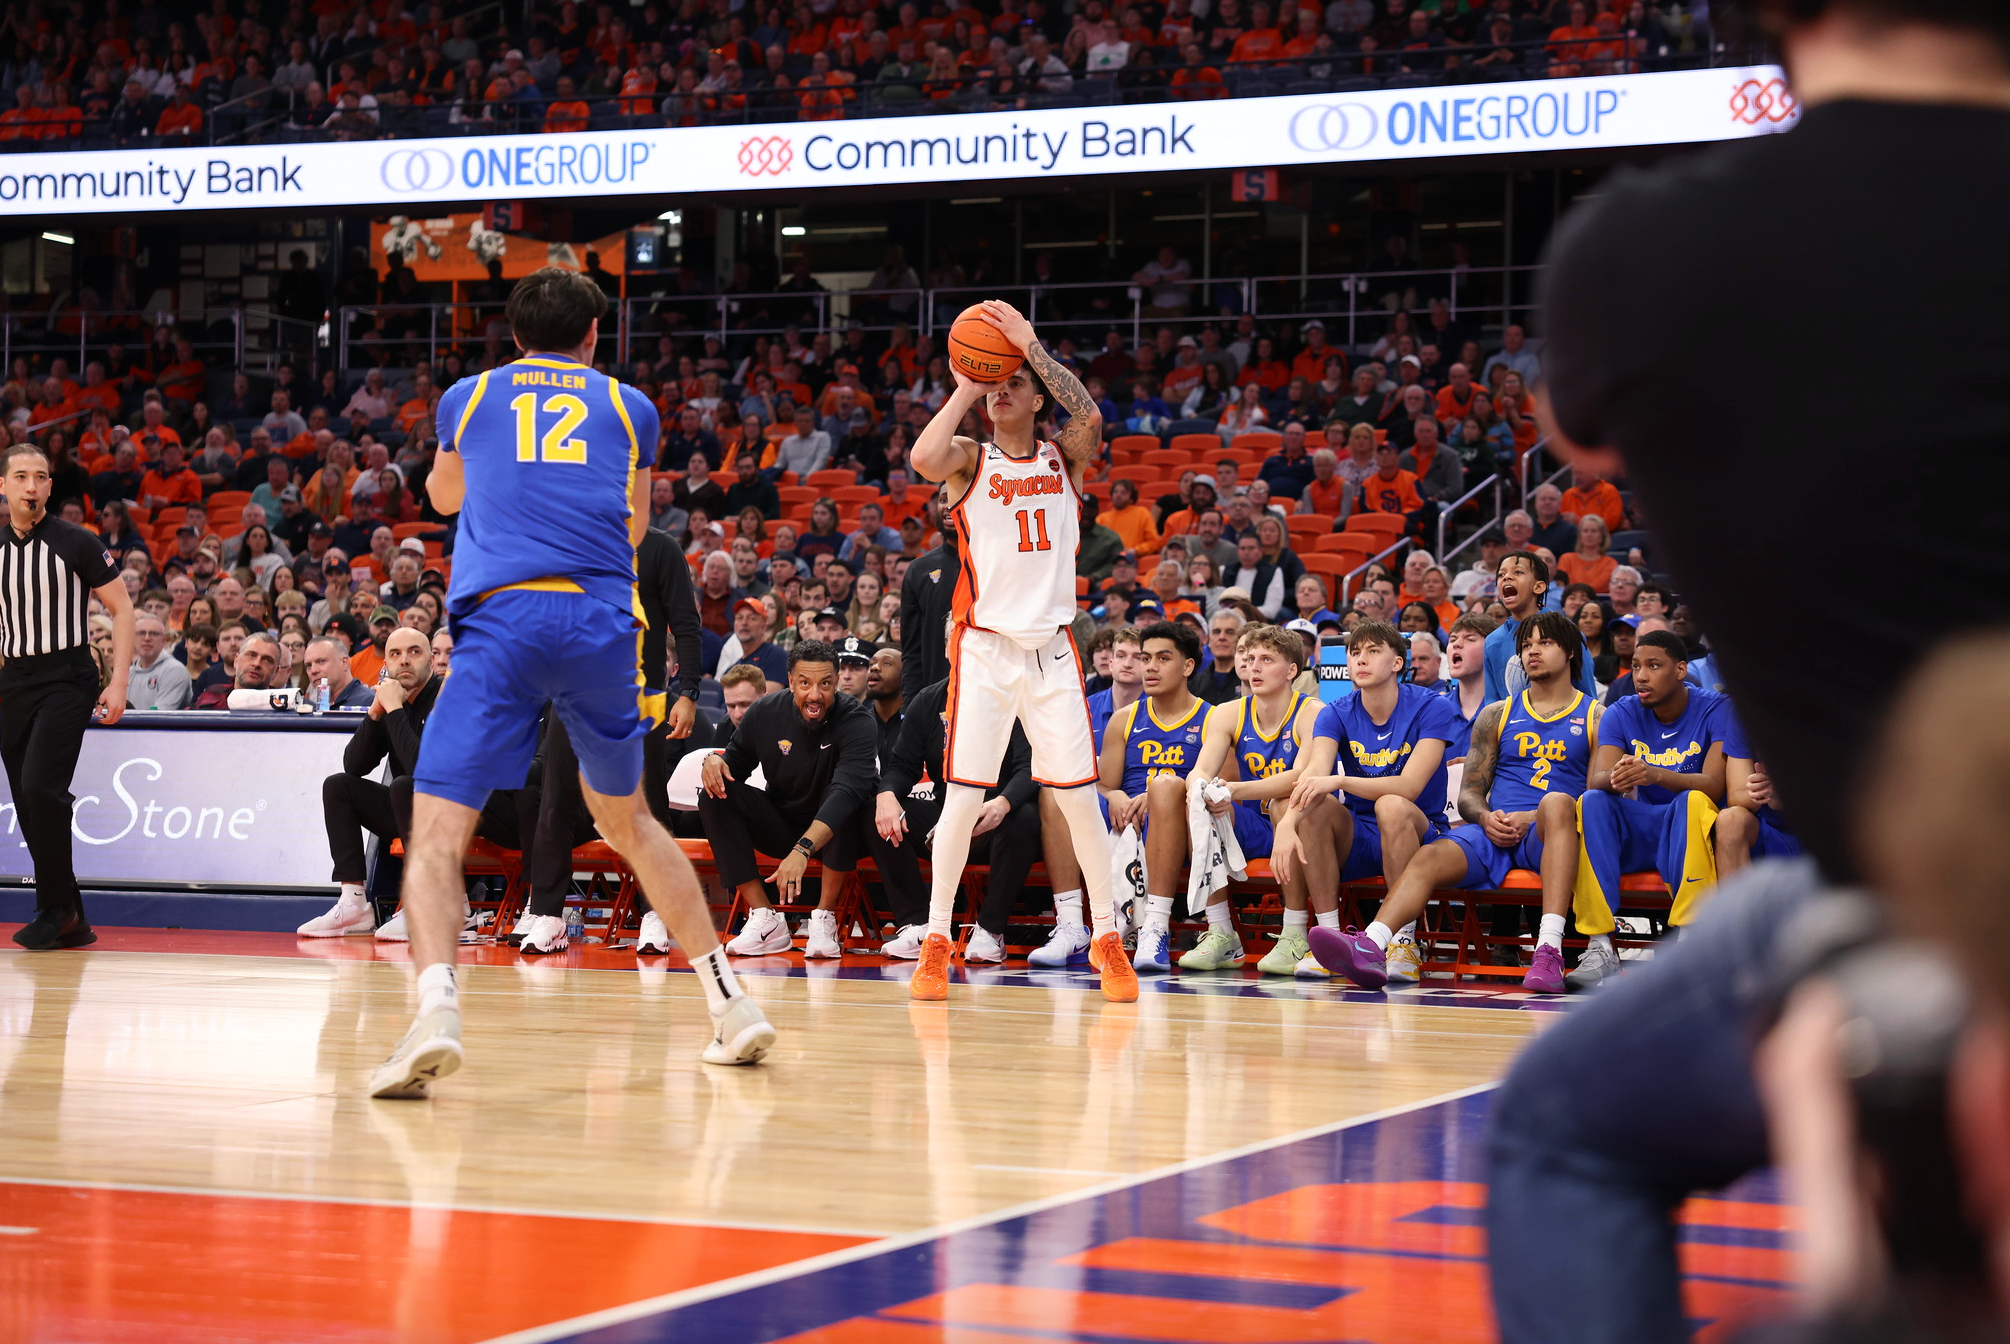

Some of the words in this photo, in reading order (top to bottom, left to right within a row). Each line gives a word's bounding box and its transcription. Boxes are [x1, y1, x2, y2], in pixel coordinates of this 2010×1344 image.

[805, 124, 1068, 170] Community
[1081, 115, 1196, 158] Bank
[0, 162, 196, 205] ommunity
[207, 156, 303, 194] Bank
[512, 371, 586, 389] MULLEN
[510, 392, 588, 464] 12
[988, 473, 1064, 506] Syracuse
[1015, 509, 1051, 552] 11
[1320, 666, 1350, 679] POWE
[1137, 740, 1186, 765] Pitt
[1513, 731, 1567, 762] Pitt
[1244, 752, 1287, 779] Pitt
[1529, 757, 1552, 791] 2
